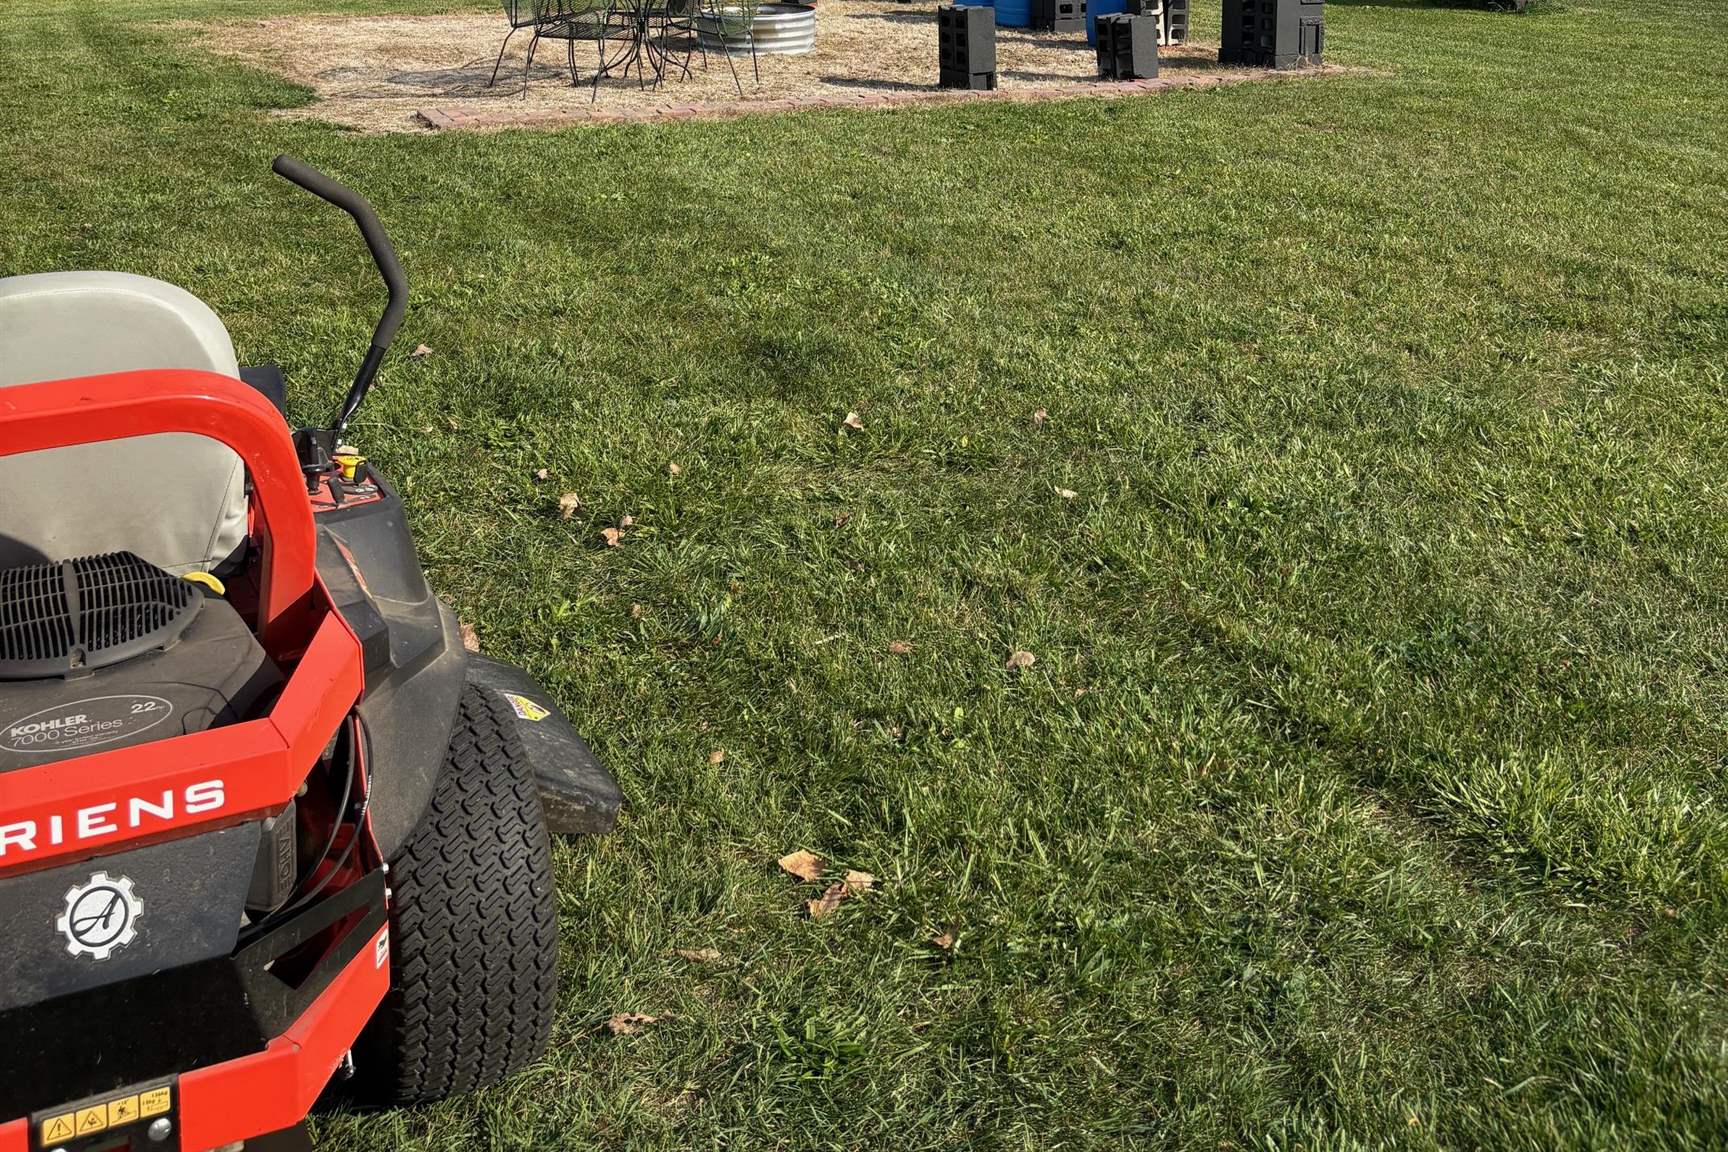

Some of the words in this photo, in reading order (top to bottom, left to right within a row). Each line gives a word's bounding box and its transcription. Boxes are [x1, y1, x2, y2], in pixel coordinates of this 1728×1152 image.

[131, 701, 156, 714] 22
[11, 714, 87, 737] KOHLER
[11, 729, 60, 747] 7000
[64, 719, 123, 737] Series
[0, 779, 225, 856] RIENS
